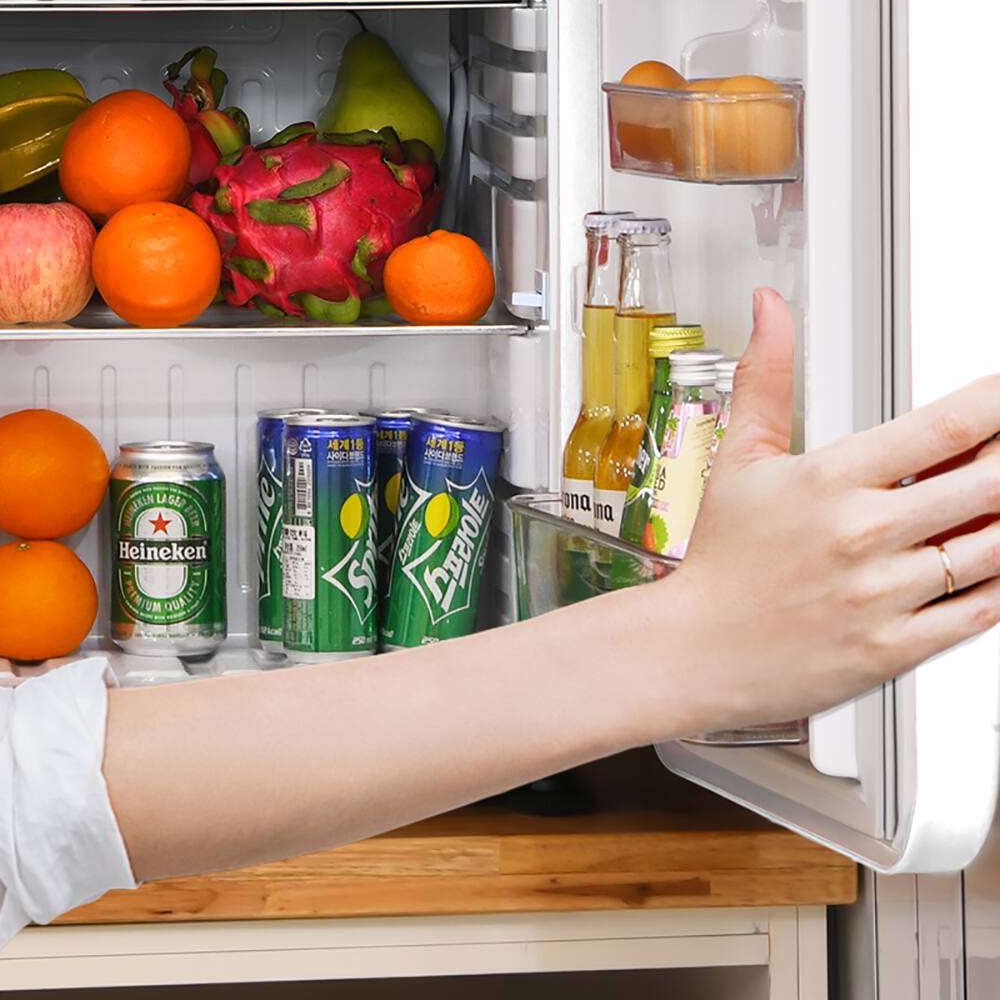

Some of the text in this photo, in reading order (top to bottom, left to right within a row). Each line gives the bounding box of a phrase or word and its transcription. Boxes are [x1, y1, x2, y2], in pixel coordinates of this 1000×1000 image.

[156, 493, 187, 508] LAGER
[119, 541, 207, 561] Heineken
[164, 580, 200, 611] QUALITY
